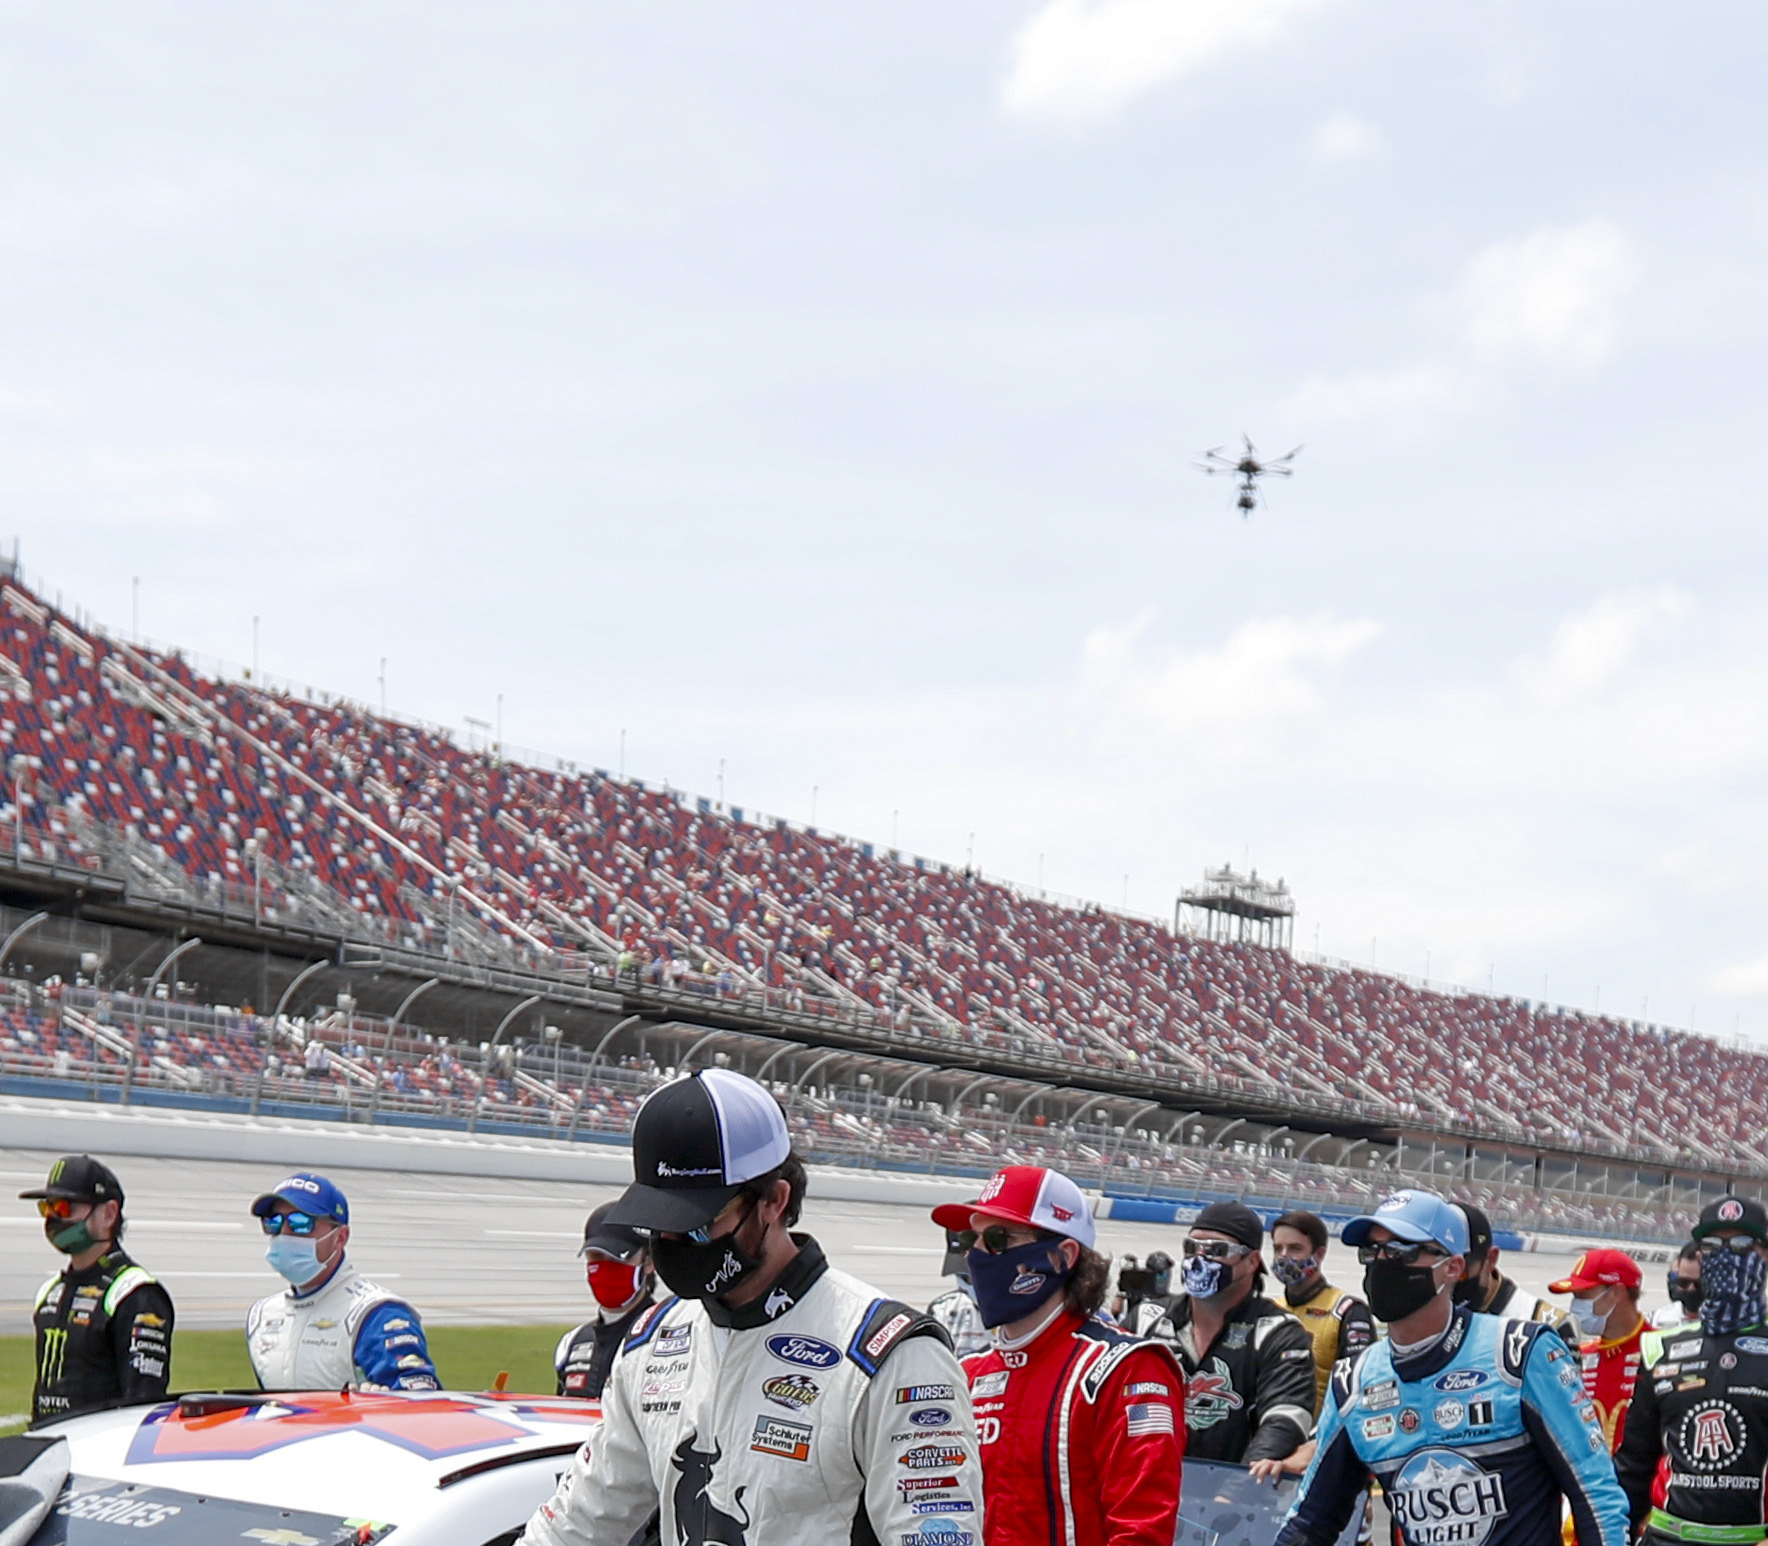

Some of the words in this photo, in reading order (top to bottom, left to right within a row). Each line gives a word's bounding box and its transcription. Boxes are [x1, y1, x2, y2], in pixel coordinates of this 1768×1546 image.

[868, 1318, 906, 1355] SIMPSON
[781, 1338, 828, 1365] Ford
[1136, 1382, 1170, 1396] NASCAR
[1442, 1371, 1479, 1390] Ford
[917, 1411, 945, 1425] Ford
[1433, 1403, 1465, 1421] BUSCH
[891, 1434, 914, 1443] FORD
[913, 1430, 965, 1440] PERFORMANC
[976, 1416, 1002, 1446] ED
[751, 1432, 793, 1450] Systems
[896, 1476, 944, 1491] Superior
[1718, 1474, 1761, 1490] SPORTS
[902, 1490, 951, 1504] Logistics
[1392, 1474, 1505, 1527] BUSCH
[57, 1490, 182, 1529] SERIES
[1415, 1521, 1480, 1545] LIGHT
